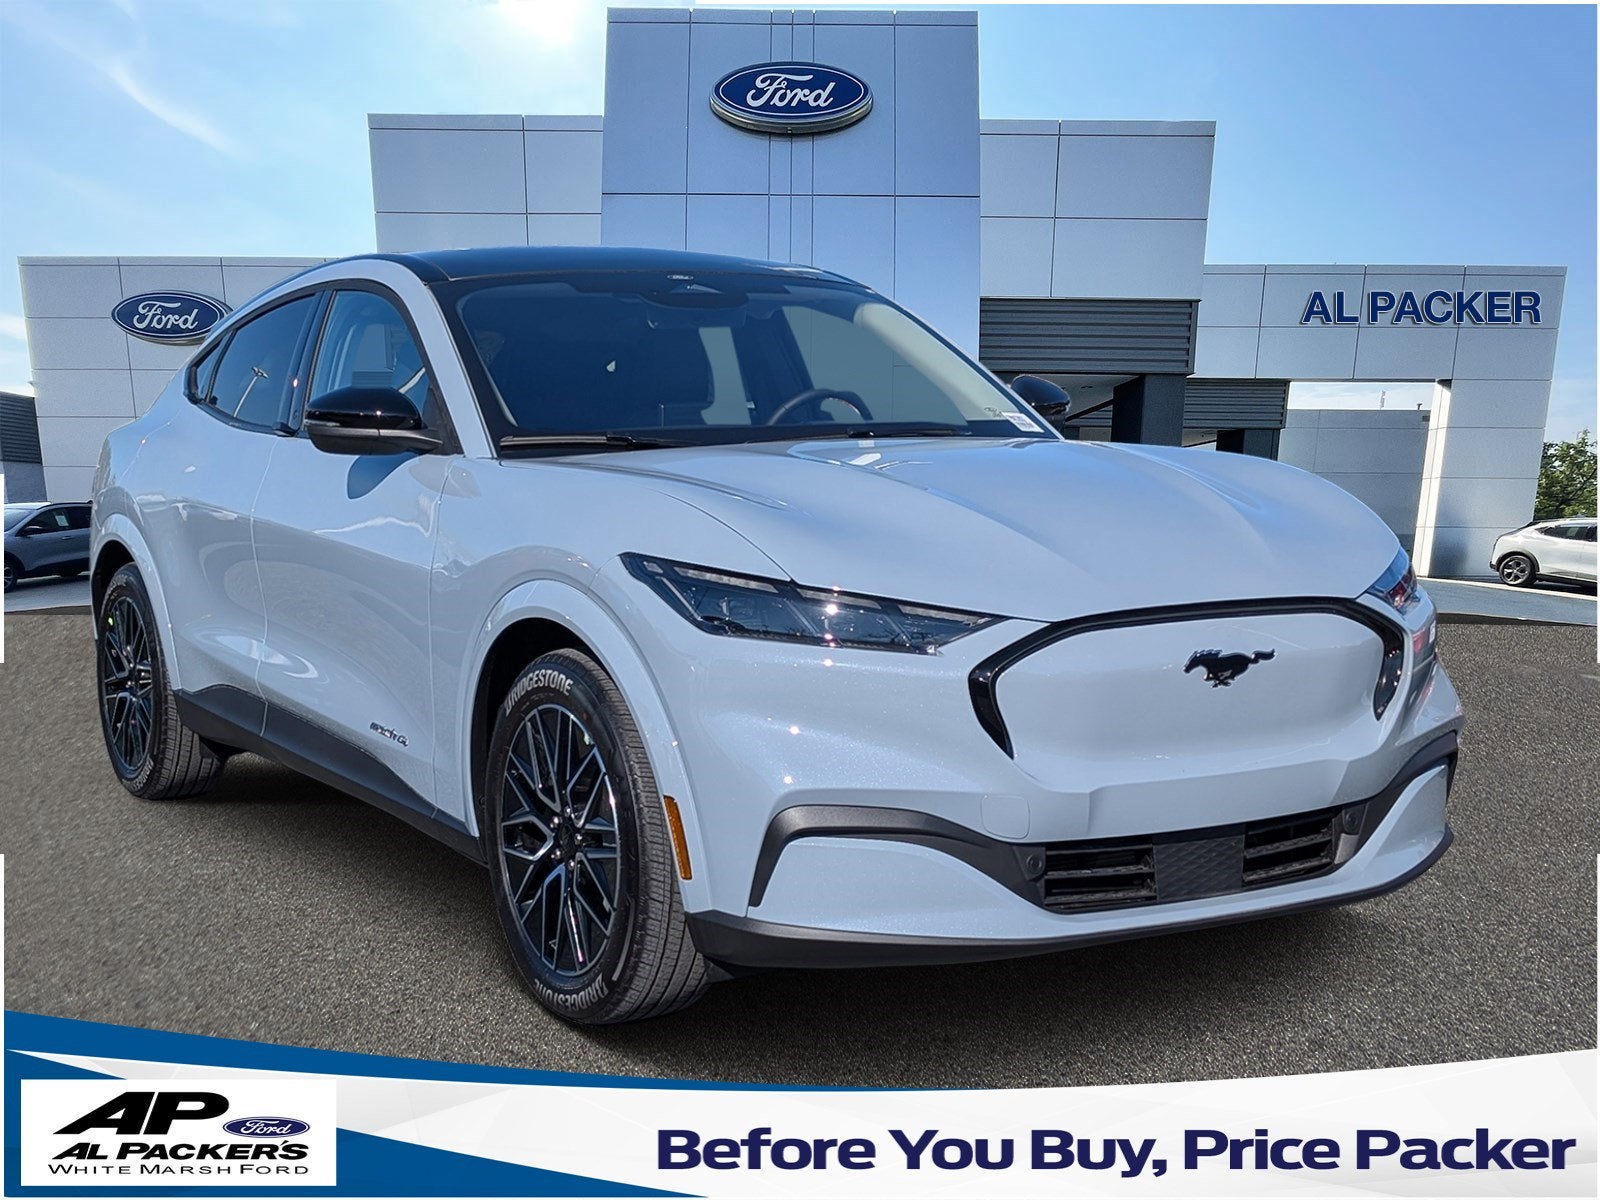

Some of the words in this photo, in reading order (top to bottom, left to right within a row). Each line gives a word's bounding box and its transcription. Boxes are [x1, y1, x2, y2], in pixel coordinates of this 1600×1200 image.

[746, 73, 836, 107] Ford
[133, 301, 198, 329] Ford
[1302, 290, 1360, 324] AL
[1369, 290, 1542, 324] PACKER
[505, 669, 574, 717] BRIDGESTONE
